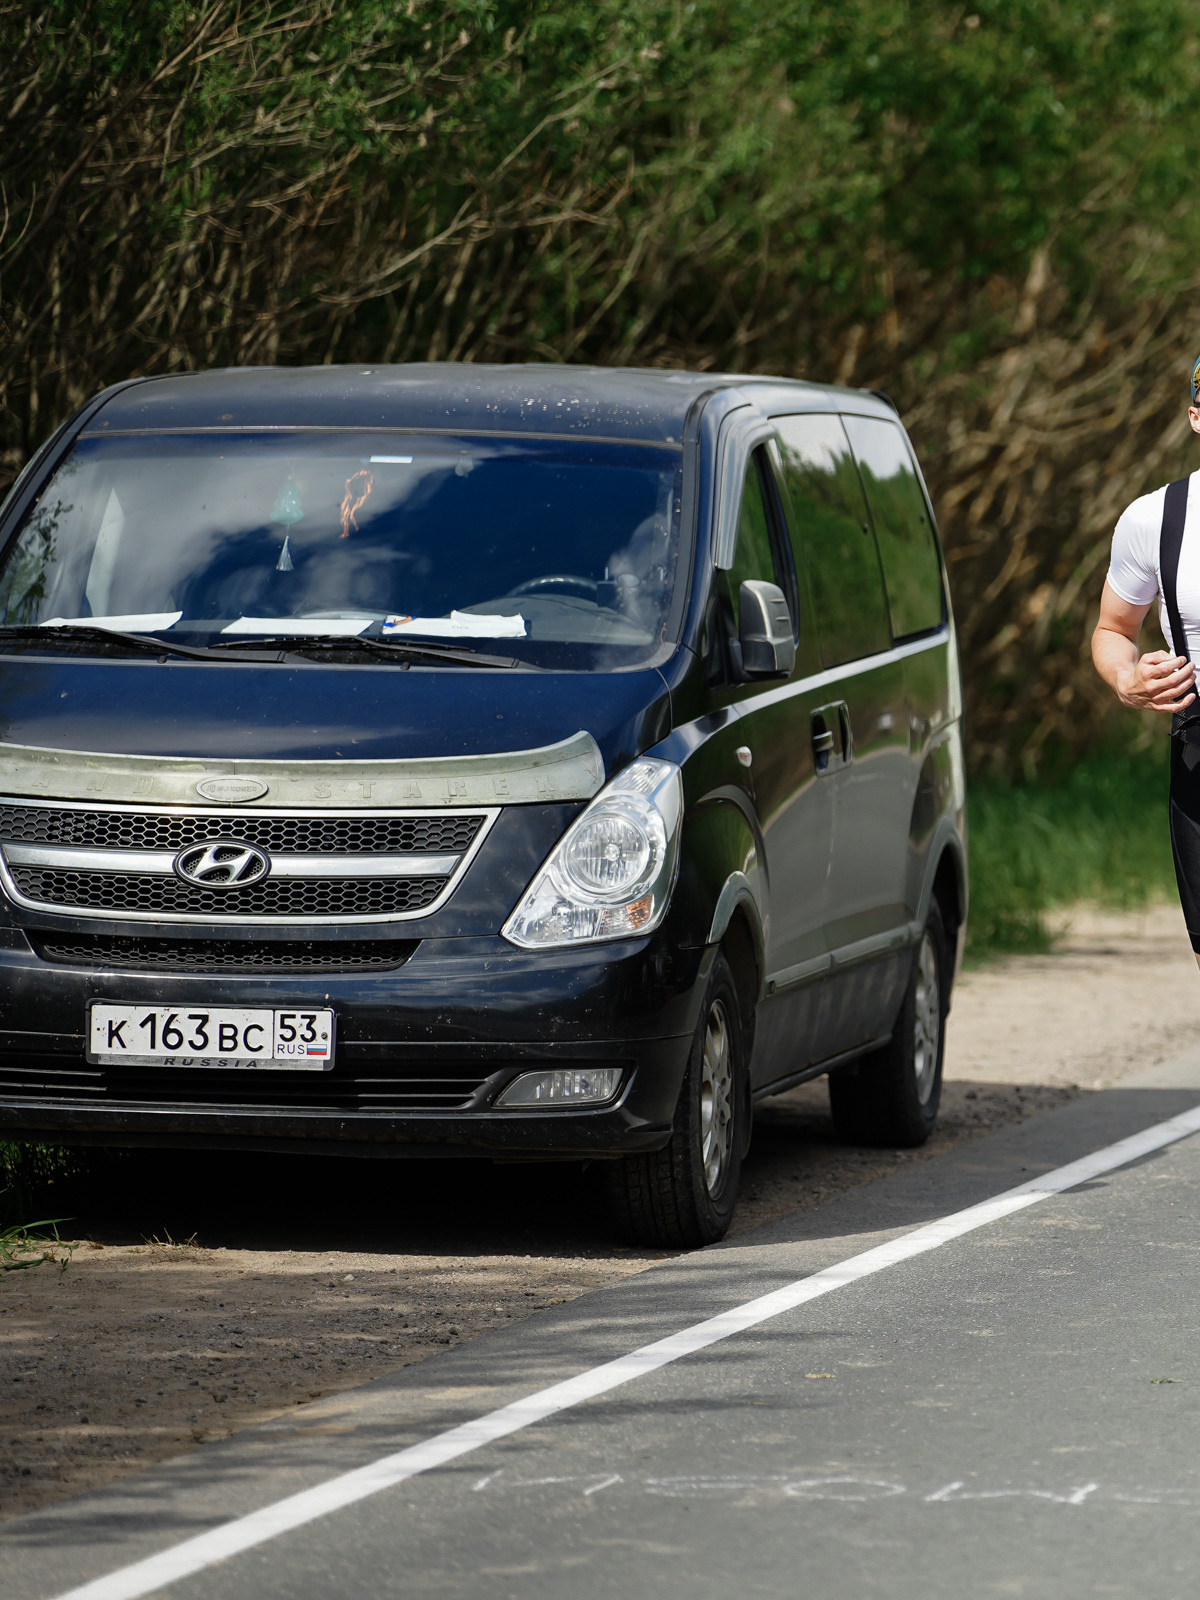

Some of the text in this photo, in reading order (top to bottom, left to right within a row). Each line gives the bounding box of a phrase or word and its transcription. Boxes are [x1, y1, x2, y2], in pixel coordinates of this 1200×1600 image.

[278, 1013, 317, 1043] 53
[276, 1043, 305, 1055] RUS
[163, 1057, 259, 1069] RUSSIA
